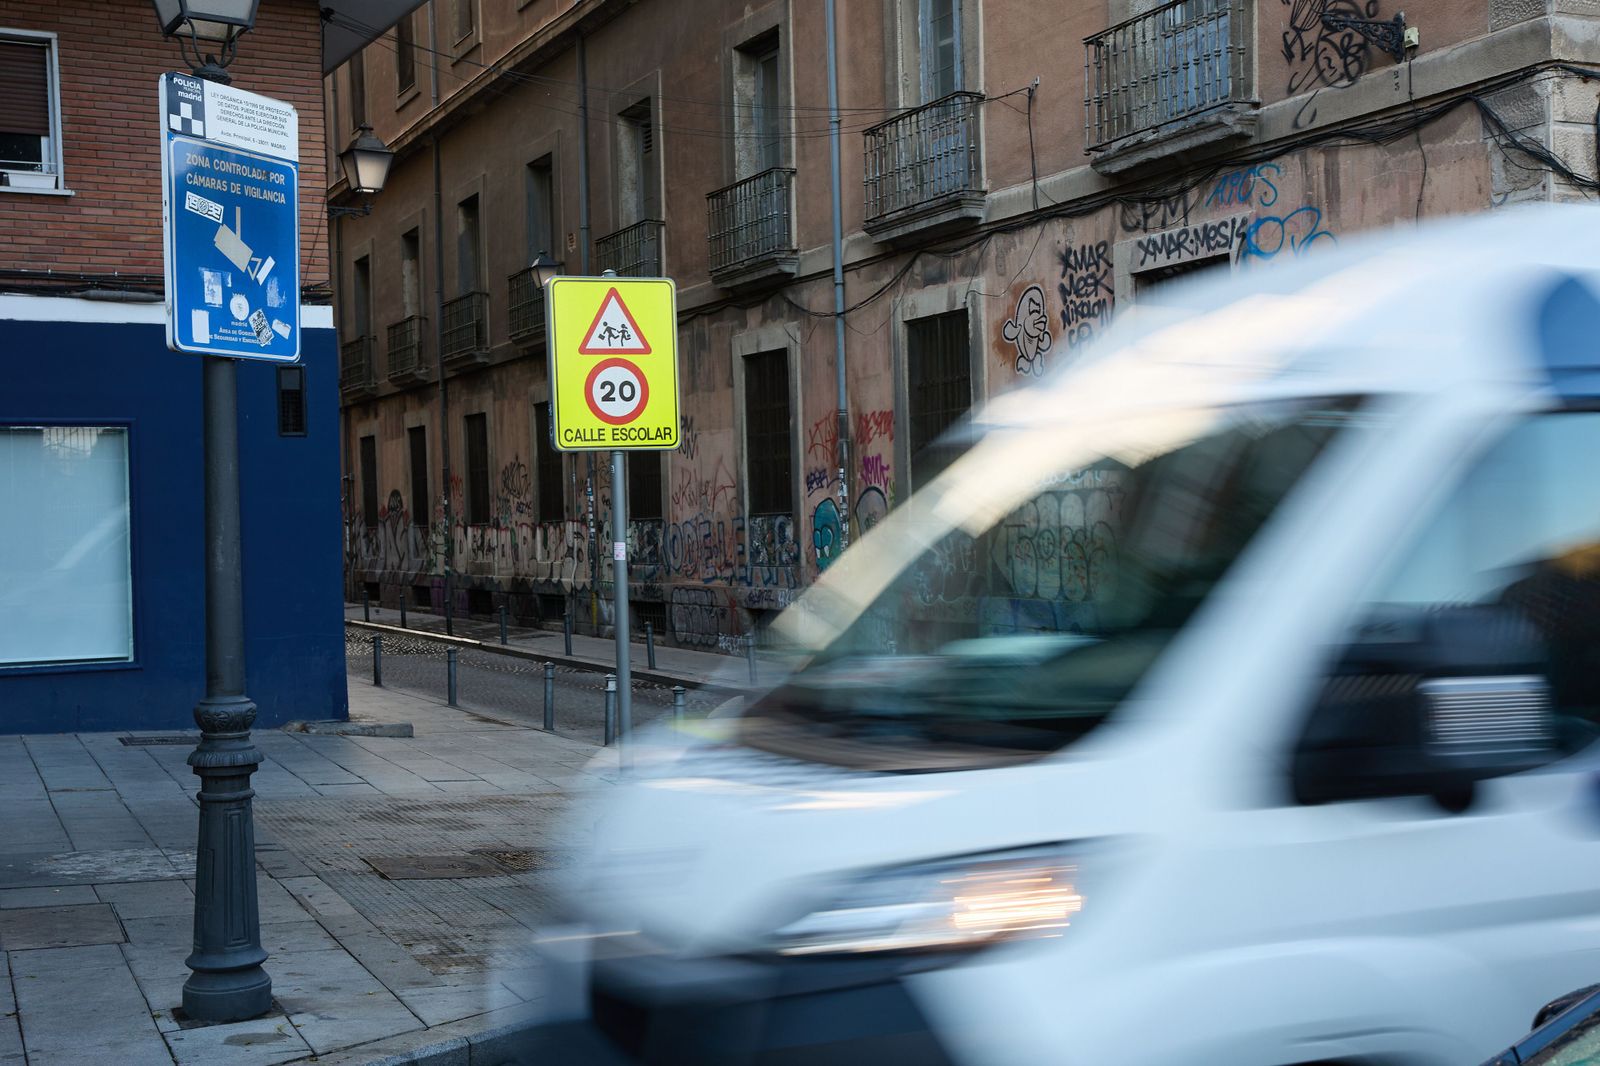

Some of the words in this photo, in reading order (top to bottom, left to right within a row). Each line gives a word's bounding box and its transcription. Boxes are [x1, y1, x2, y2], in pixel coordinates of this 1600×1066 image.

[173, 77, 202, 91] POLICÍA
[178, 90, 202, 102] madrid
[220, 108, 244, 119] DERECHOS
[245, 114, 256, 122] ANTE
[216, 114, 238, 125] GENERAL
[268, 127, 289, 138] MUNICIPAL
[270, 142, 286, 151] MADRID
[186, 152, 211, 170] ZONA
[213, 158, 268, 182] CONTROLADA
[269, 170, 286, 186] POR
[186, 171, 228, 192] CÁMARAS
[230, 180, 241, 194] DE
[243, 184, 286, 205] VIGILANCIA
[1058, 240, 1114, 278] XMAR
[600, 380, 636, 402] 20
[564, 428, 606, 443] CALLE
[612, 427, 672, 442] ESCOLAR
